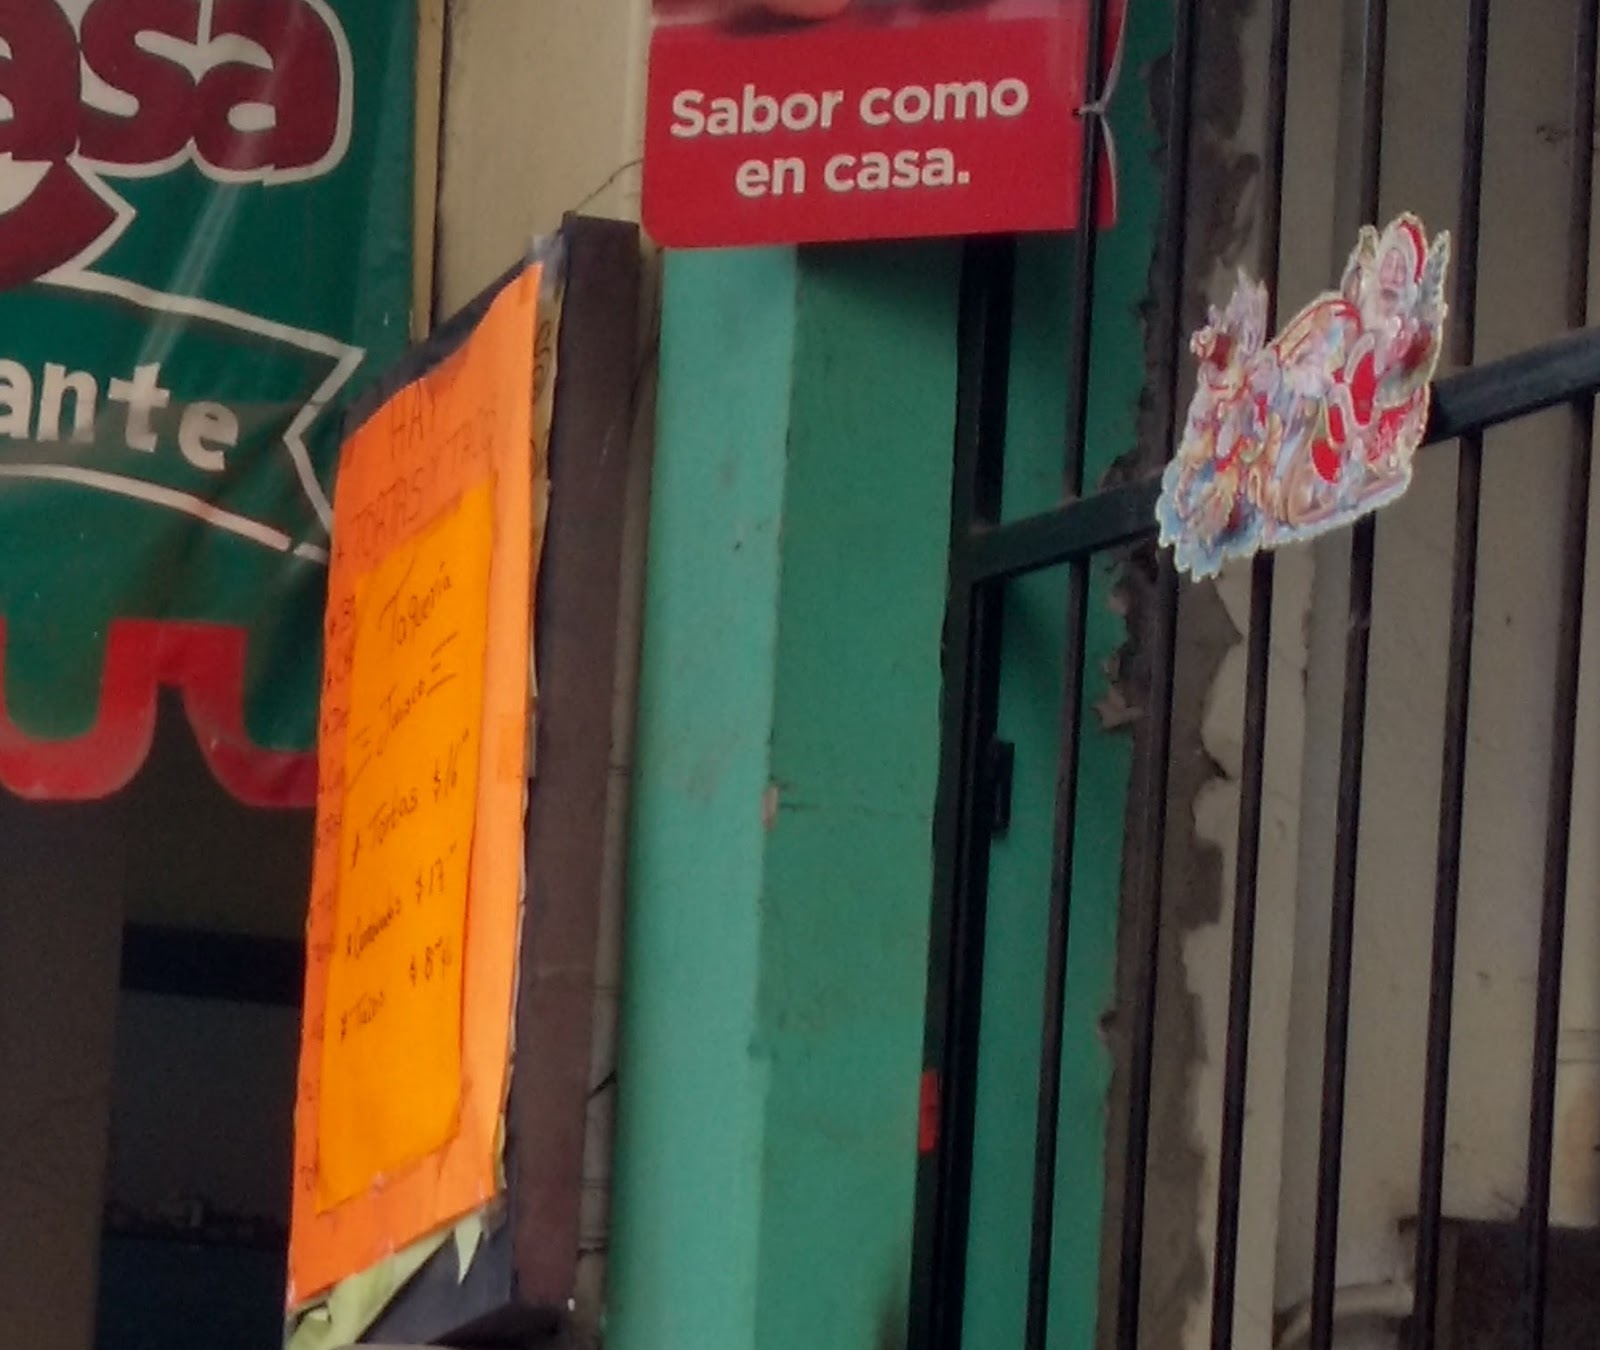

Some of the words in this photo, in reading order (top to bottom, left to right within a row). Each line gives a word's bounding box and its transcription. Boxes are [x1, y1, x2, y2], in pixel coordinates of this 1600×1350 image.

[670, 83, 845, 139] Sabor
[859, 73, 1030, 127] como
[734, 156, 806, 198] en
[823, 146, 971, 194] casa.
